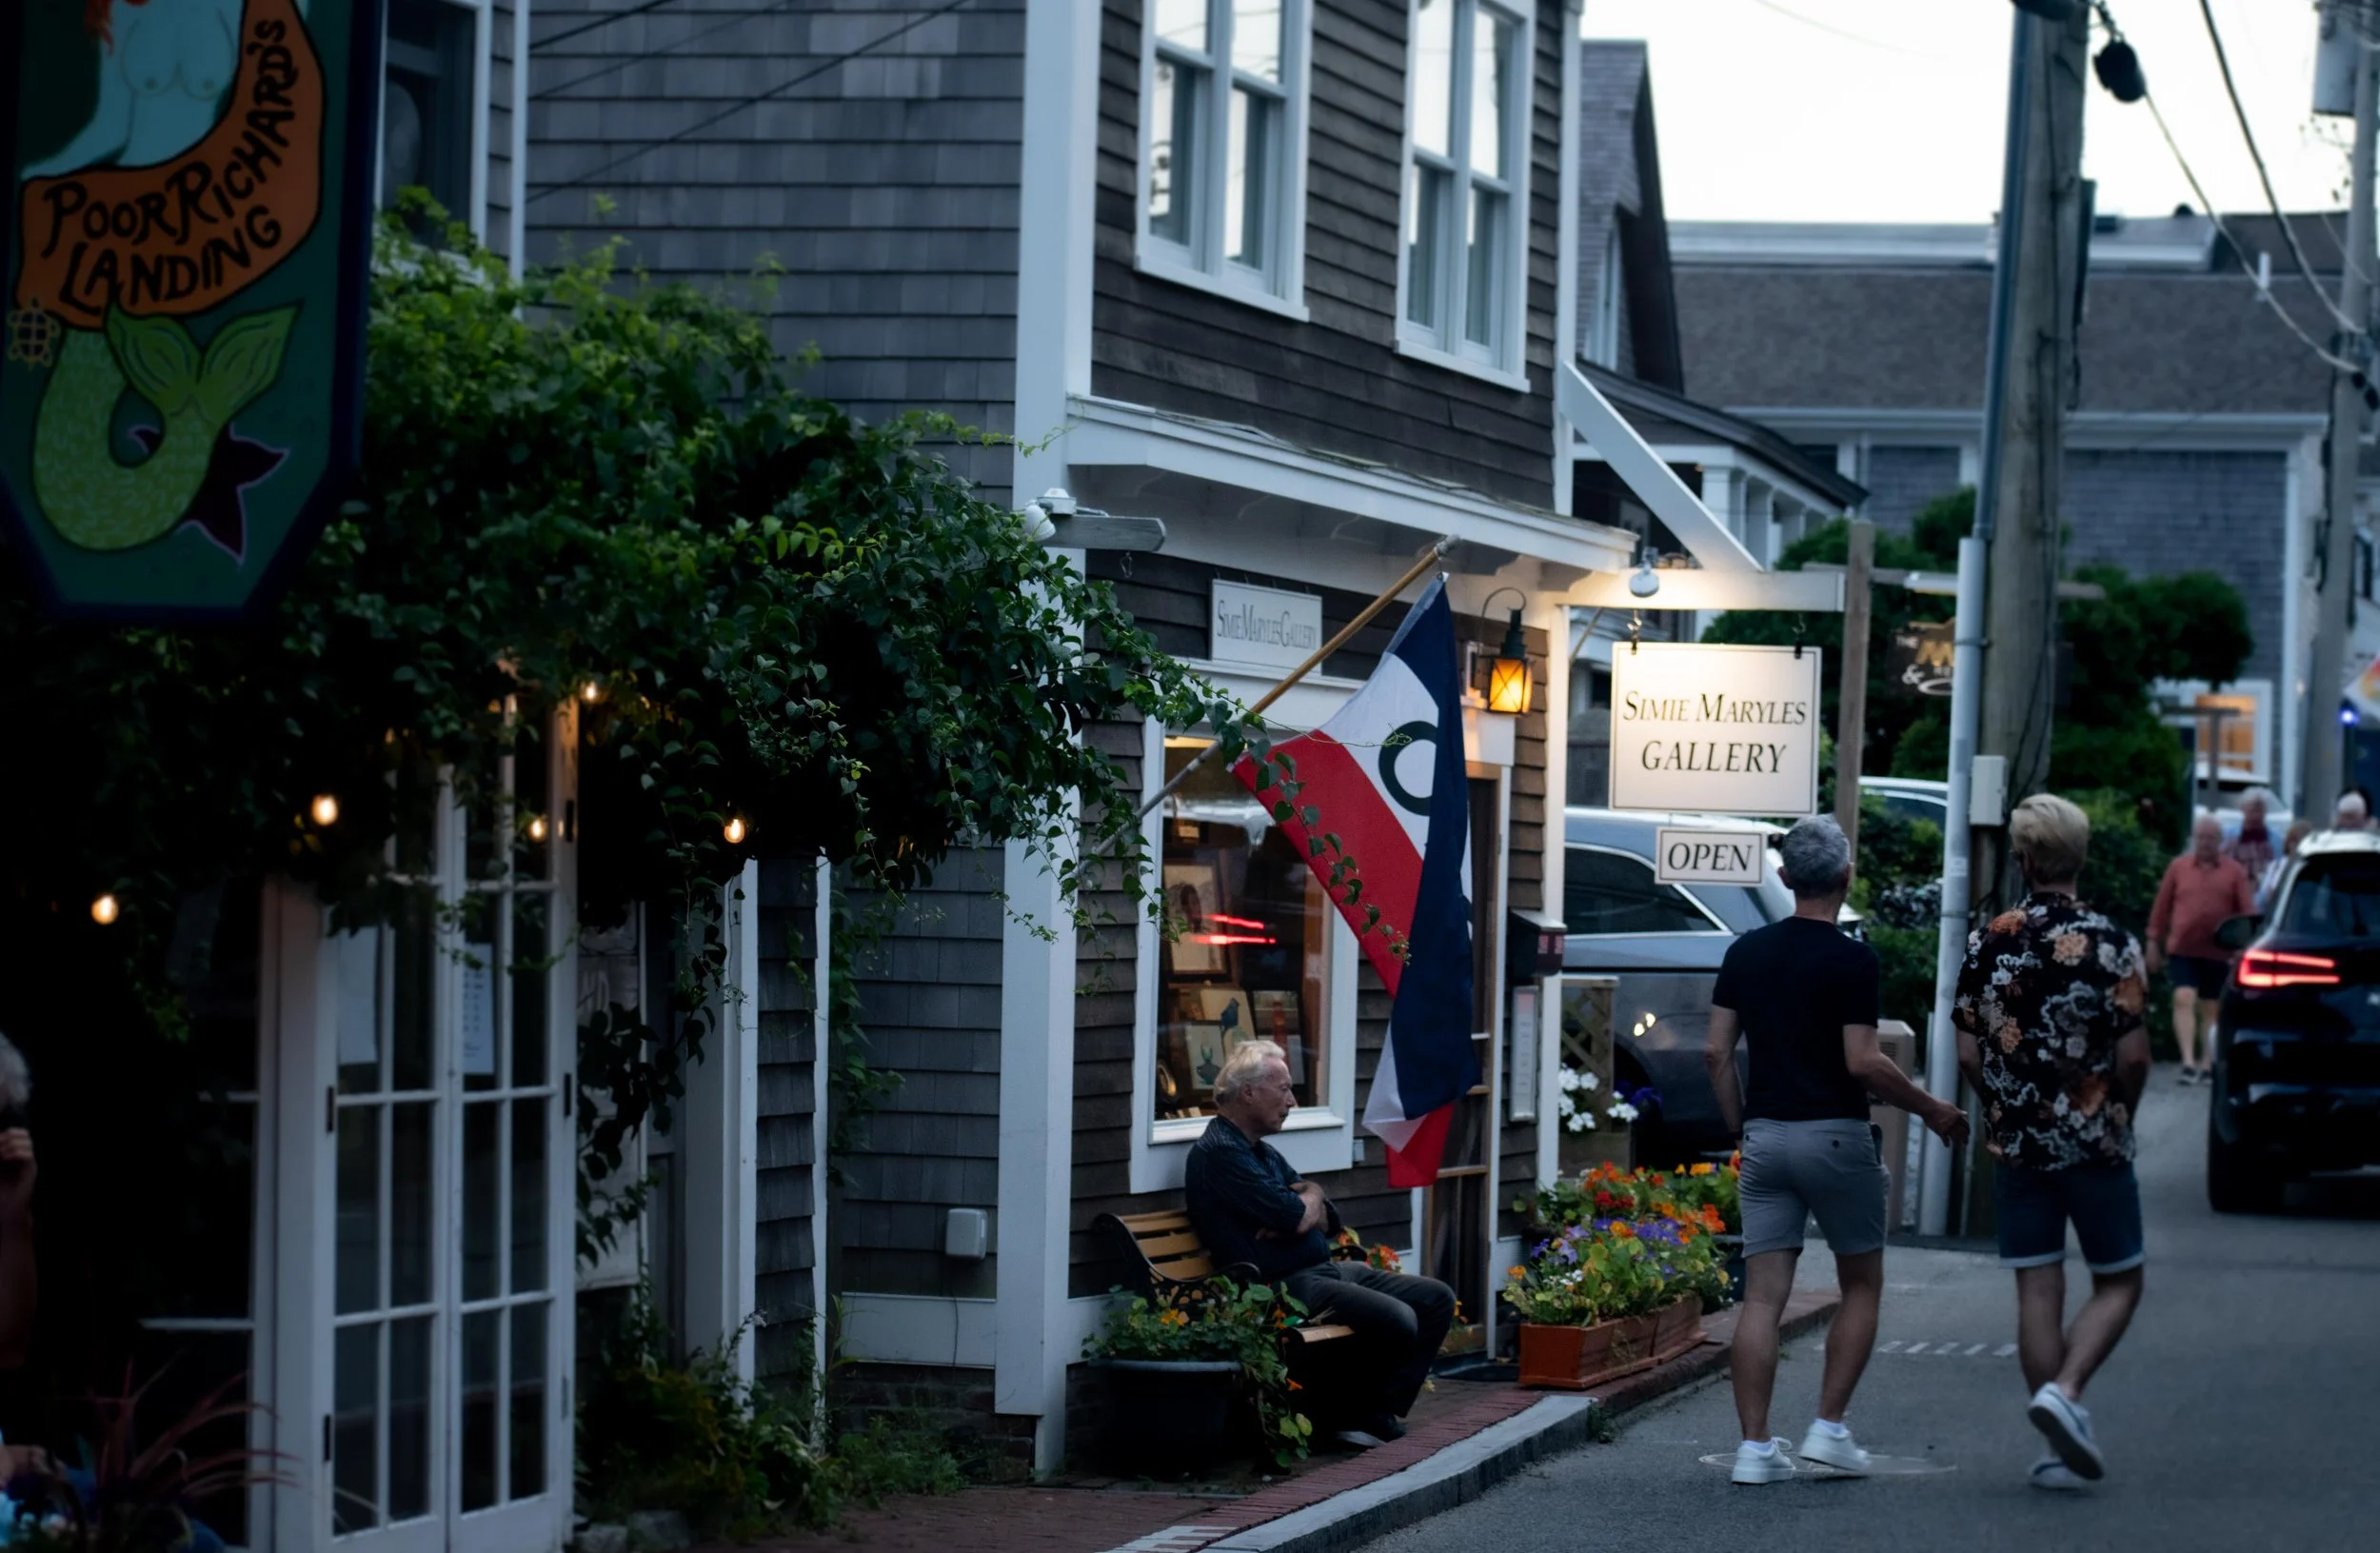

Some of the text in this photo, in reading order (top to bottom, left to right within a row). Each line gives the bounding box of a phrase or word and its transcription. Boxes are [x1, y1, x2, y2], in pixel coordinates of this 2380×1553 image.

[41, 19, 298, 258] POOR RICHARD'S
[58, 204, 282, 315] LANDING
[1622, 690, 1806, 726] SIMIE MARYLES
[1641, 740, 1787, 774] GALLERY
[1668, 842, 1753, 872] OPEN
